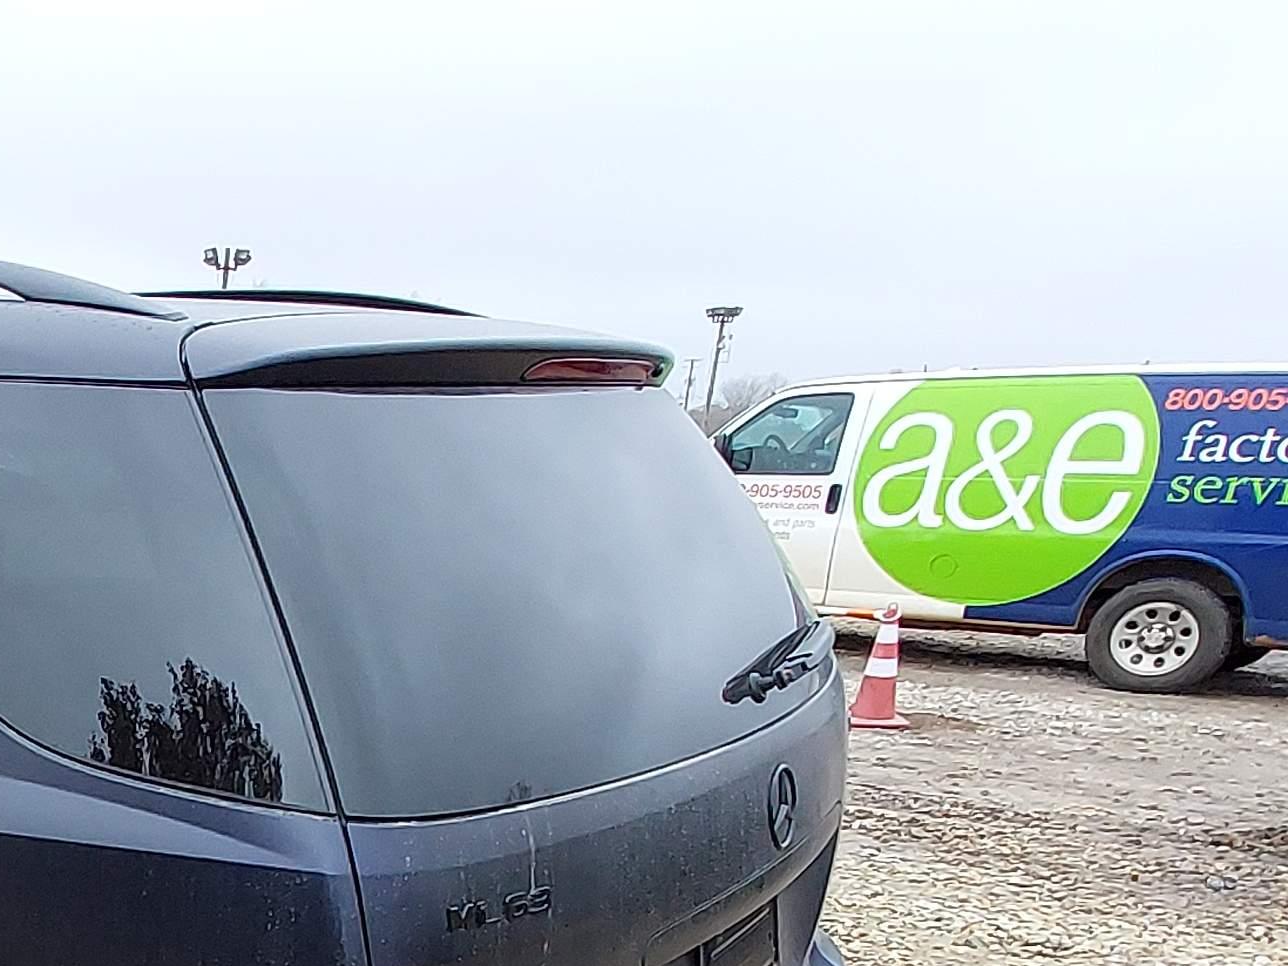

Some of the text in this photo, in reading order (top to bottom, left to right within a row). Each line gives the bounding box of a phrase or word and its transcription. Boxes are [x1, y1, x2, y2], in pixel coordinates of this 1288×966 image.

[862, 408, 1145, 536] a&e
[740, 483, 823, 499] -905-9505
[758, 502, 820, 511] service.com
